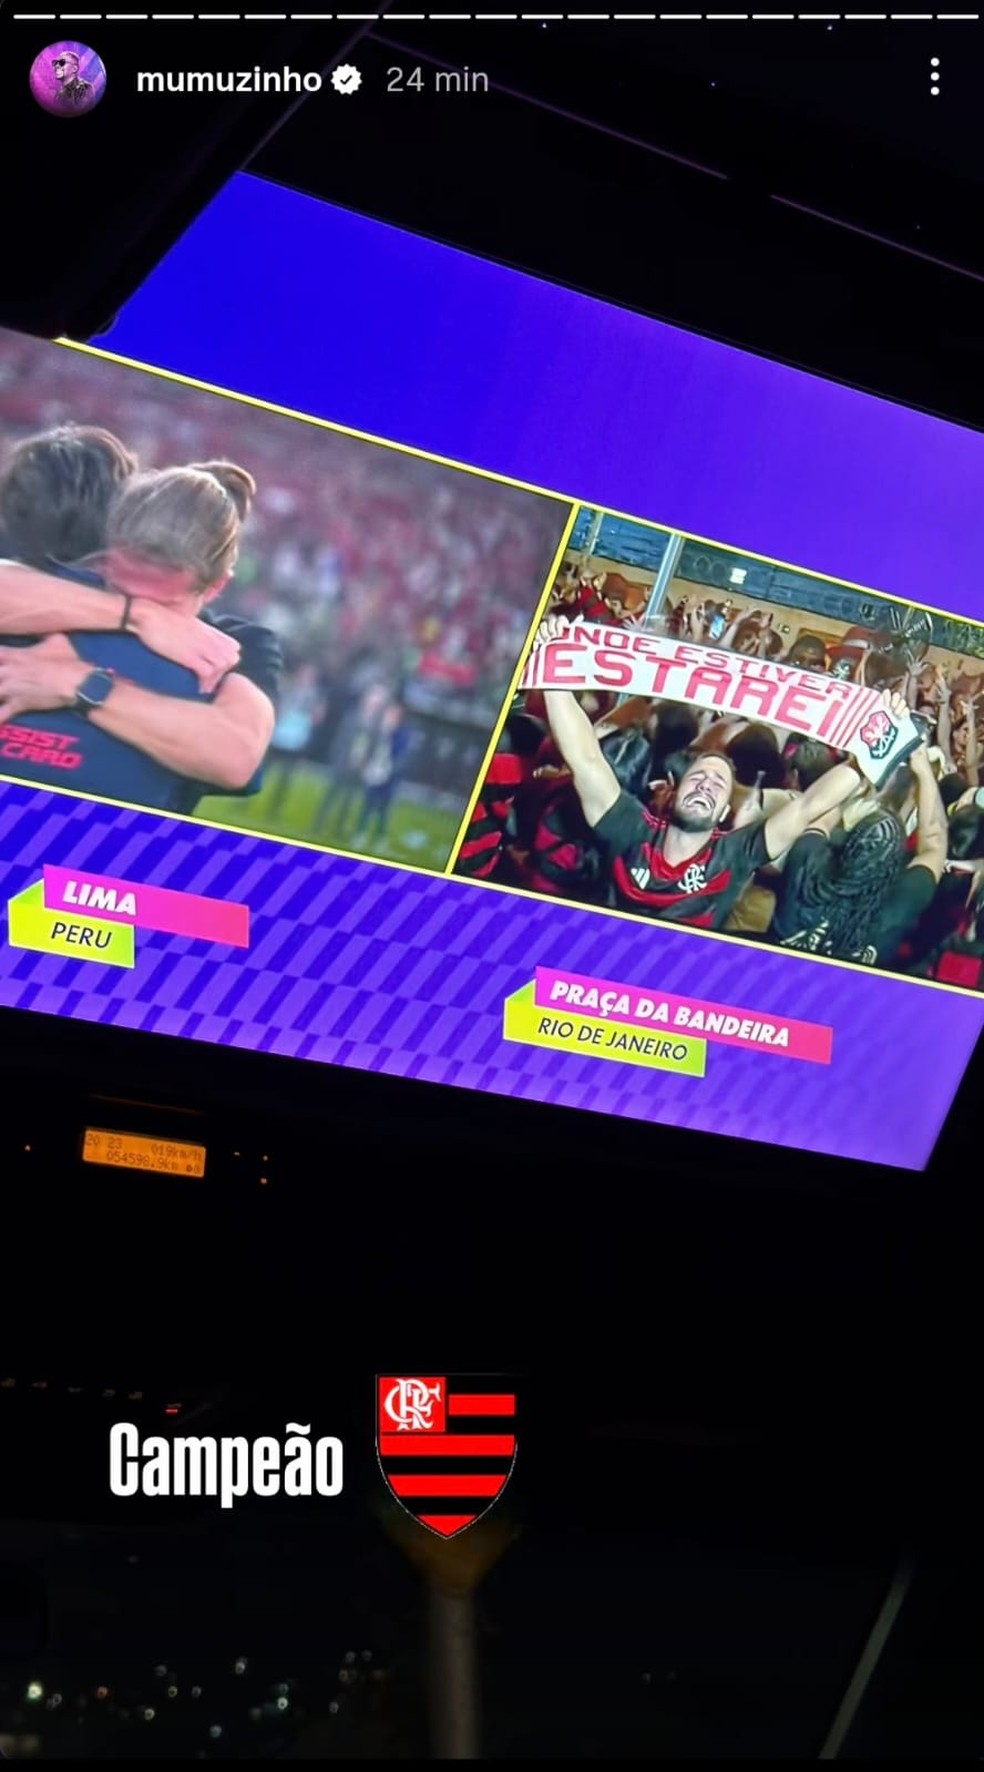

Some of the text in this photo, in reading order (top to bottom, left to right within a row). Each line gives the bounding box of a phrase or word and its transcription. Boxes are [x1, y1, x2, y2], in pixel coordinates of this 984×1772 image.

[542, 642, 844, 737] ESTAREI
[674, 645, 854, 697] ESTIVER
[62, 880, 137, 915] LIMA
[51, 921, 112, 949] PERU
[549, 979, 789, 1047] PRAÇA DA BANDEIRA
[538, 1017, 688, 1061] RIO DE JANEIRO
